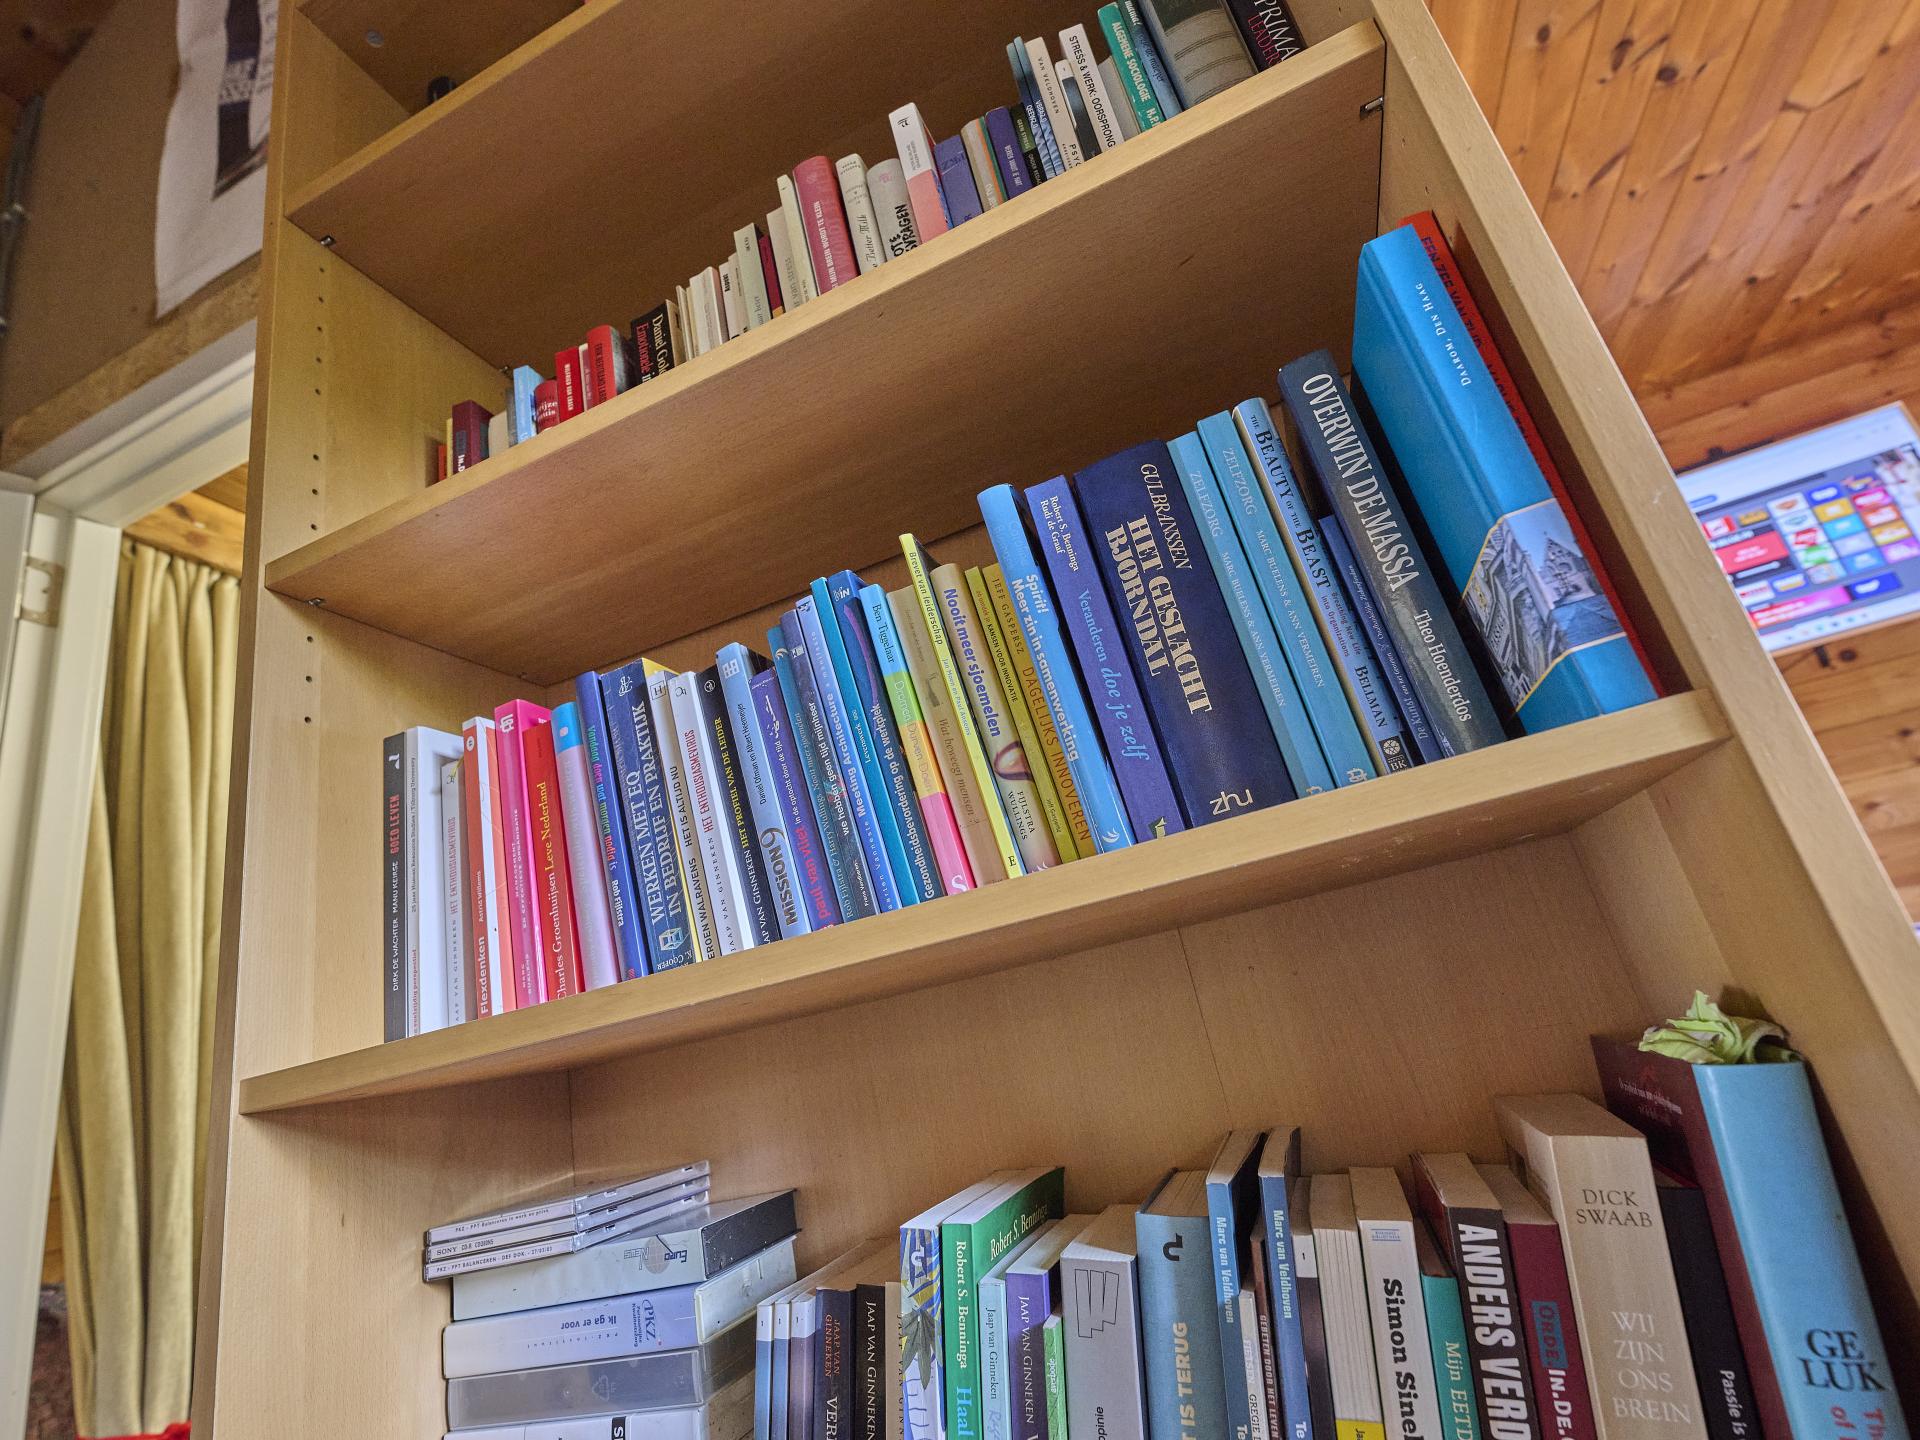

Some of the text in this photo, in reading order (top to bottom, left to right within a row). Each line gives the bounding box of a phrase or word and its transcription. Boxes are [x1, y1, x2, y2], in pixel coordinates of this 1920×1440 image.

[1068, 35, 1085, 64] STRESS
[1082, 71, 1096, 97] WERK:
[1091, 97, 1116, 147] OORSPRONG
[1111, 21, 1133, 59] ALGEMENE
[1126, 58, 1150, 102] SOCIOLOGIE
[651, 314, 666, 349] Daniel
[1415, 282, 1446, 335] DEN HAAG
[1189, 470, 1223, 537] ZELFZORG
[1222, 447, 1257, 515] ZELFZORG
[1255, 429, 1330, 587] BEAUTY BEAST
[1303, 374, 1418, 590] OVERWIN DE MASSA
[1039, 499, 1065, 553] Rudi de Graaf
[1049, 495, 1078, 571] Robert S. Benninga
[1140, 463, 1191, 568] GULBRANSSEN
[908, 551, 946, 645] Brevet van leiderschap
[1021, 573, 1049, 613] Spirit!
[1127, 515, 1211, 711] HET GESLACHT
[1287, 609, 1301, 629] ANN
[871, 604, 894, 663] Ben Tiggelaar
[943, 588, 1000, 736] Nooit meer sjoemelen
[986, 623, 1018, 702] KANSEN VOOR INNOVATIE
[1413, 609, 1471, 721] Theo Hoenderdos
[1011, 578, 1078, 761] Meer zin in samenwerking
[1078, 589, 1149, 760] Veranderen doe je zelf
[1354, 665, 1387, 727] BELLMAN
[808, 702, 849, 835] we hebben geen tijd mijnheer
[826, 693, 866, 817] Meeting Architecture
[389, 794, 399, 824] LEVEN
[536, 781, 551, 839] Nederland
[631, 701, 681, 915] IN BEDRIJF EN PRAKTIJK
[669, 765, 692, 846] HET IS ALTIJD NU
[684, 729, 728, 918] VAN HET ENTHOUSIASMEVIRUS
[713, 716, 766, 927] VAN GINNEKEN HET PROFIEL VAN DE LEIDER
[870, 703, 934, 898] Gezondheidsbevordering op de werkplek
[1007, 790, 1027, 840] WULLINGS
[1050, 751, 1092, 840] INNOVEREN
[1209, 788, 1253, 815] zhu
[389, 827, 399, 853] GOED
[544, 842, 554, 869] Leve
[625, 770, 667, 924] WERKEN MET EQ
[611, 880, 620, 896] Rob
[688, 857, 707, 922] WALRAVENS
[804, 857, 831, 919] paul van
[392, 959, 398, 968] DE
[477, 936, 488, 1012] Flexdenken
[1576, 1209, 1653, 1228] SWAAB
[1582, 1189, 1639, 1207] DICK
[436, 1246, 457, 1255] SONY
[990, 1228, 1013, 1262] Robert
[1216, 1216, 1235, 1323] Marc van Veldhoven
[1272, 1209, 1292, 1318] Marc van Veldhoven
[865, 1301, 875, 1331] JAAP
[956, 1241, 969, 1368] Robert S. Benninga
[1459, 1224, 1514, 1346] ANDERS
[560, 1314, 616, 1330] Ik ga er voor
[867, 1335, 875, 1361] VAN
[984, 1307, 999, 1399] Jaap van Ginneken
[1383, 1278, 1406, 1363] Simon
[1806, 1328, 1863, 1360] GE
[1018, 1295, 1034, 1423] JAAP VAN GINNEKEN
[1172, 1322, 1195, 1426] IS TERUG
[1258, 1314, 1279, 1438] GEBETEN HET LEVEN
[1444, 1341, 1463, 1380] Mijn
[1618, 1369, 1673, 1393] ONS
[1799, 1359, 1890, 1391] LUK
[956, 1386, 973, 1435] Haal
[1248, 1393, 1259, 1433] GREGIE
[1614, 1397, 1691, 1424] BREIN
[1719, 1369, 1747, 1435] Passie is
